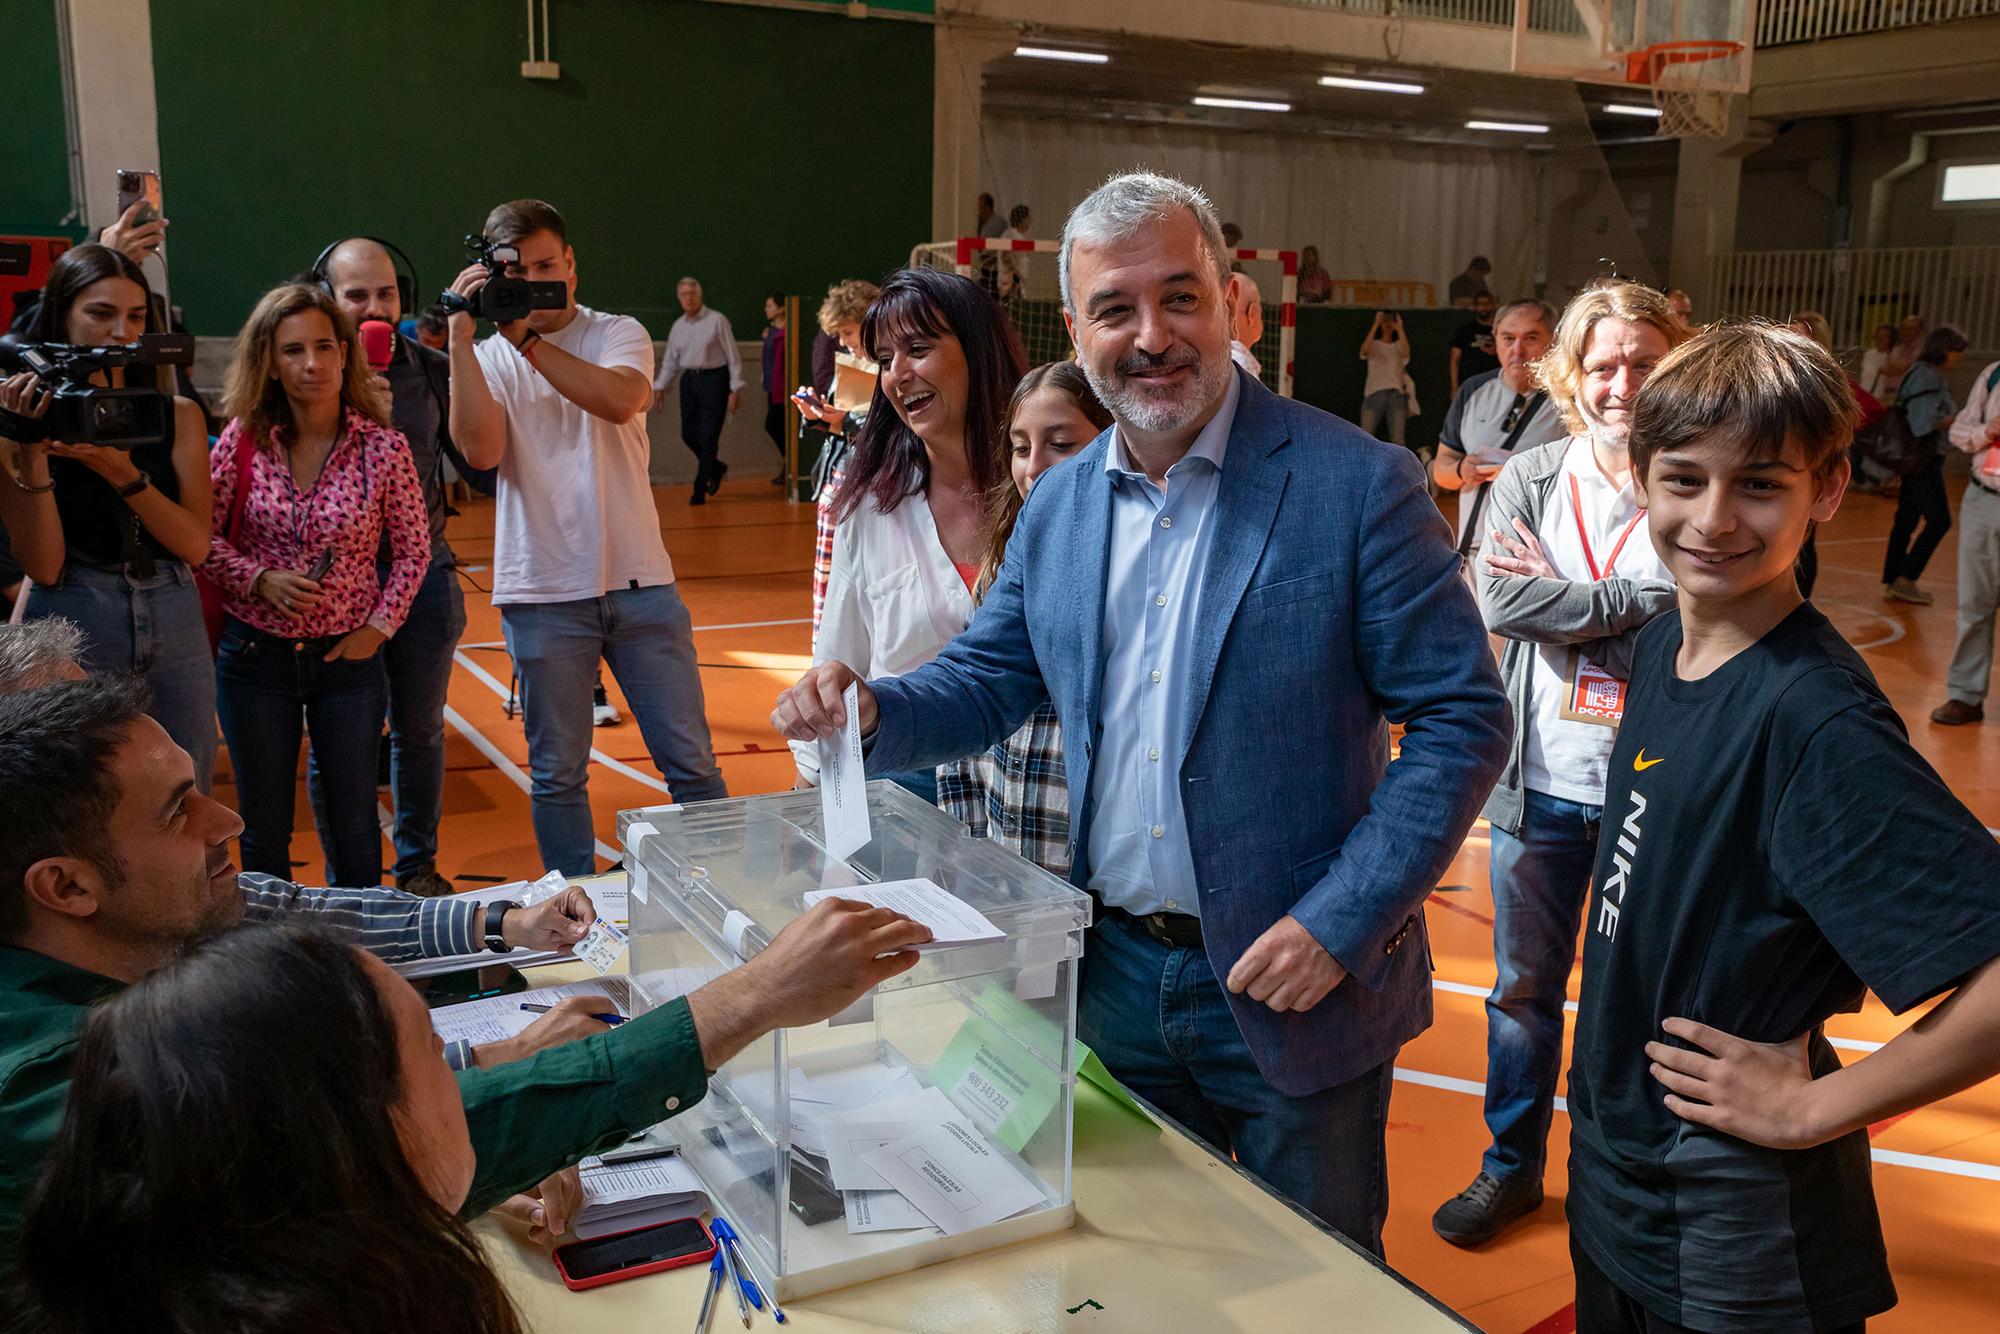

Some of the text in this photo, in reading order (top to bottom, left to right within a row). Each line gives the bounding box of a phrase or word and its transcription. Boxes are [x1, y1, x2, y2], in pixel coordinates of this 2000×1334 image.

[1597, 790, 1647, 943] NIKE
[967, 1071, 981, 1088] 900
[980, 1082, 995, 1100] 343
[992, 1093, 1009, 1110] 232
